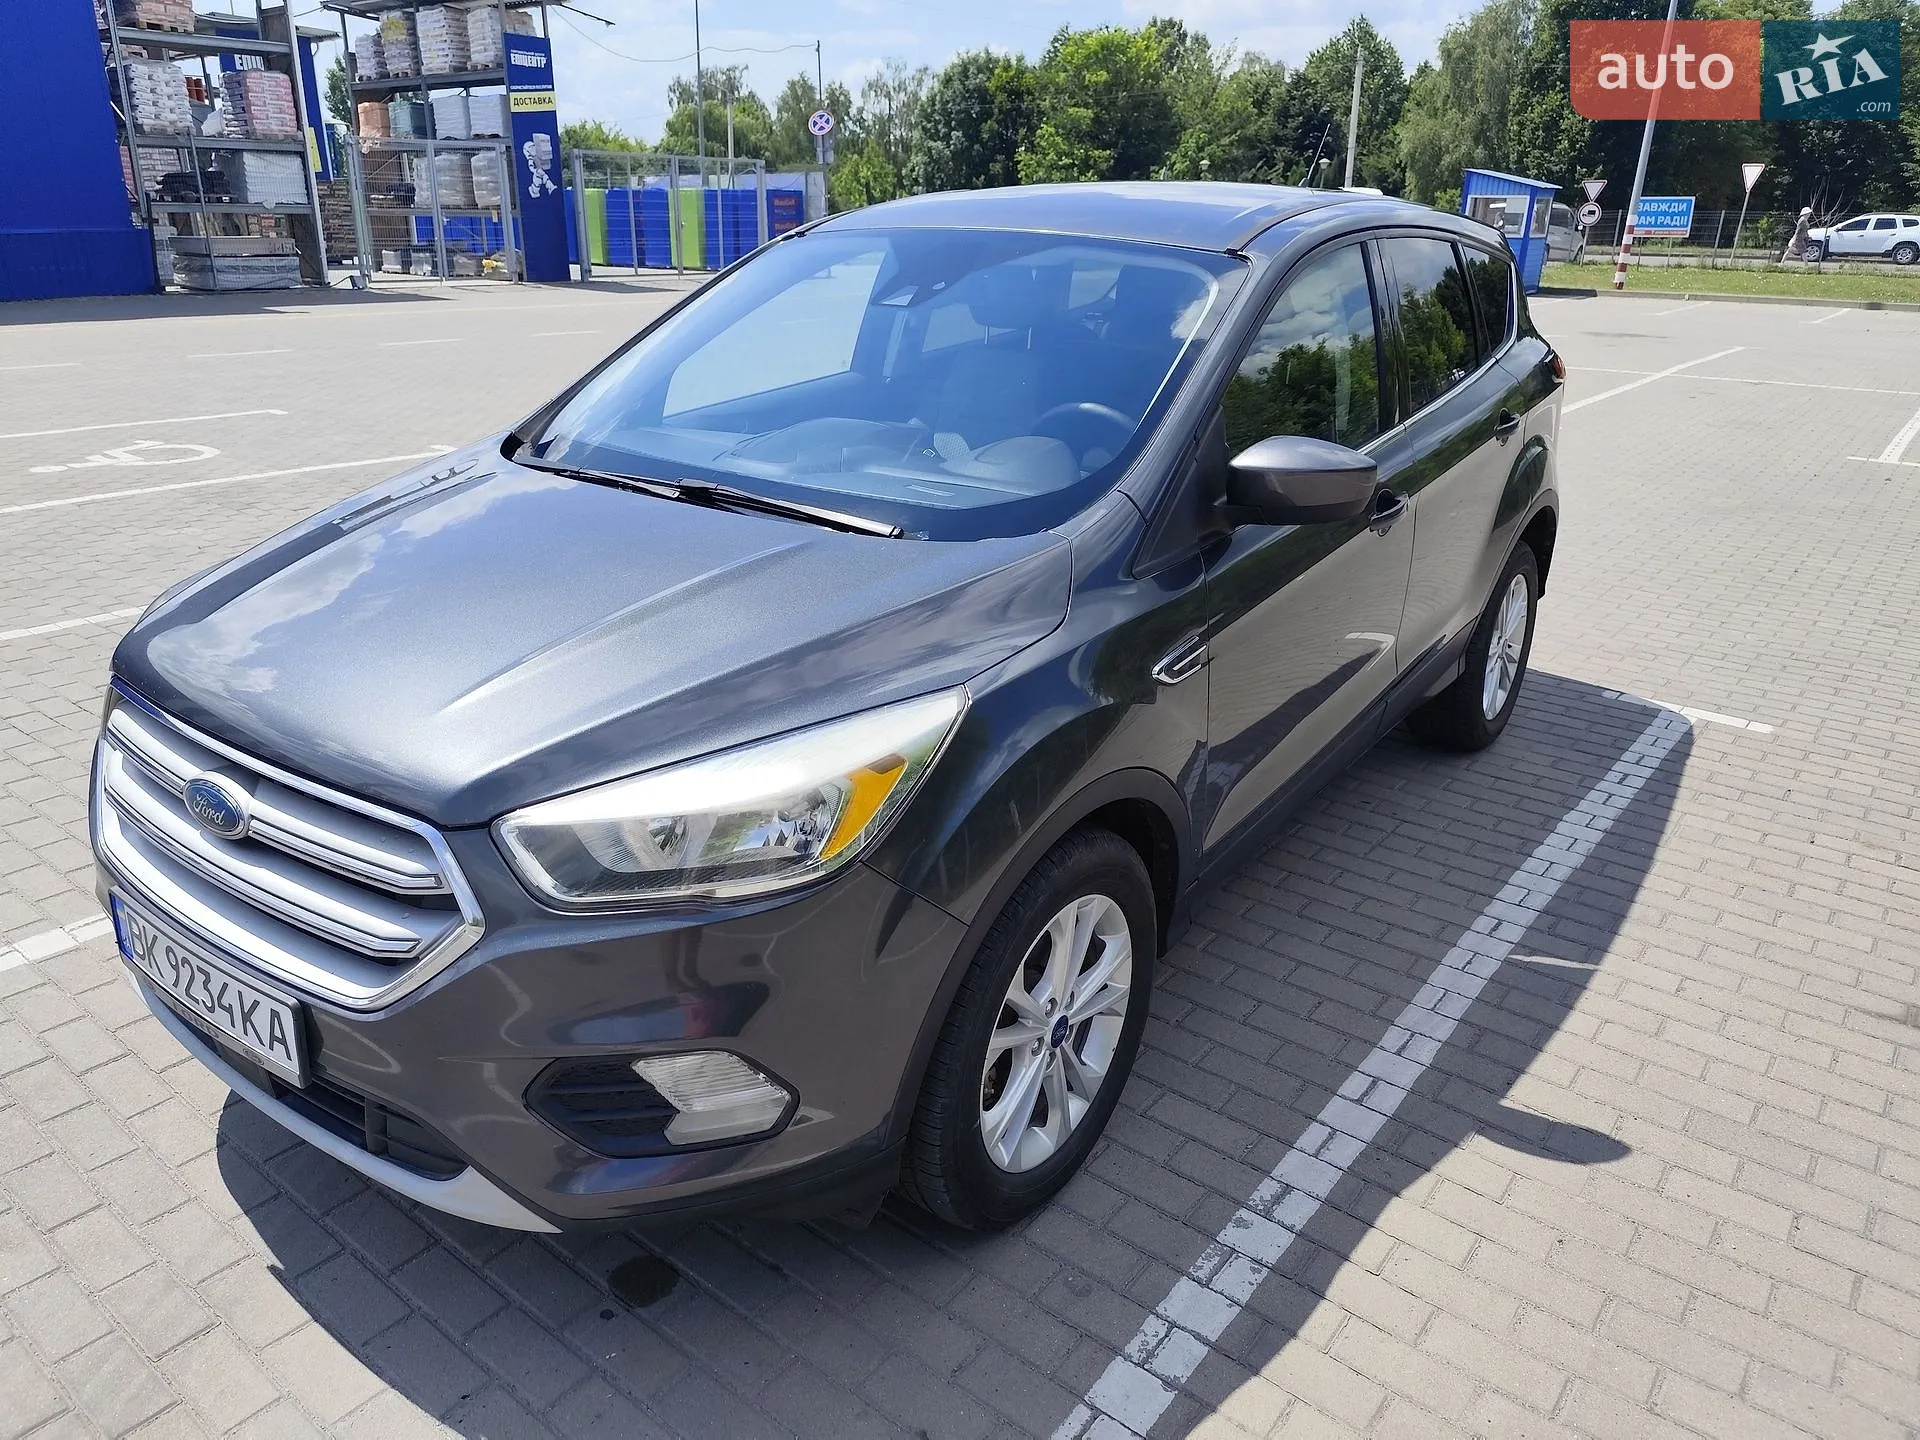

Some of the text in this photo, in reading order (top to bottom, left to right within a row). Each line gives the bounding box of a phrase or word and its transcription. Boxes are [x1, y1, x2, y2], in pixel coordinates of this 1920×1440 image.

[513, 96, 554, 106] ДОСТАВКА
[193, 791, 226, 826] Ford
[165, 945, 236, 1029] 9234
